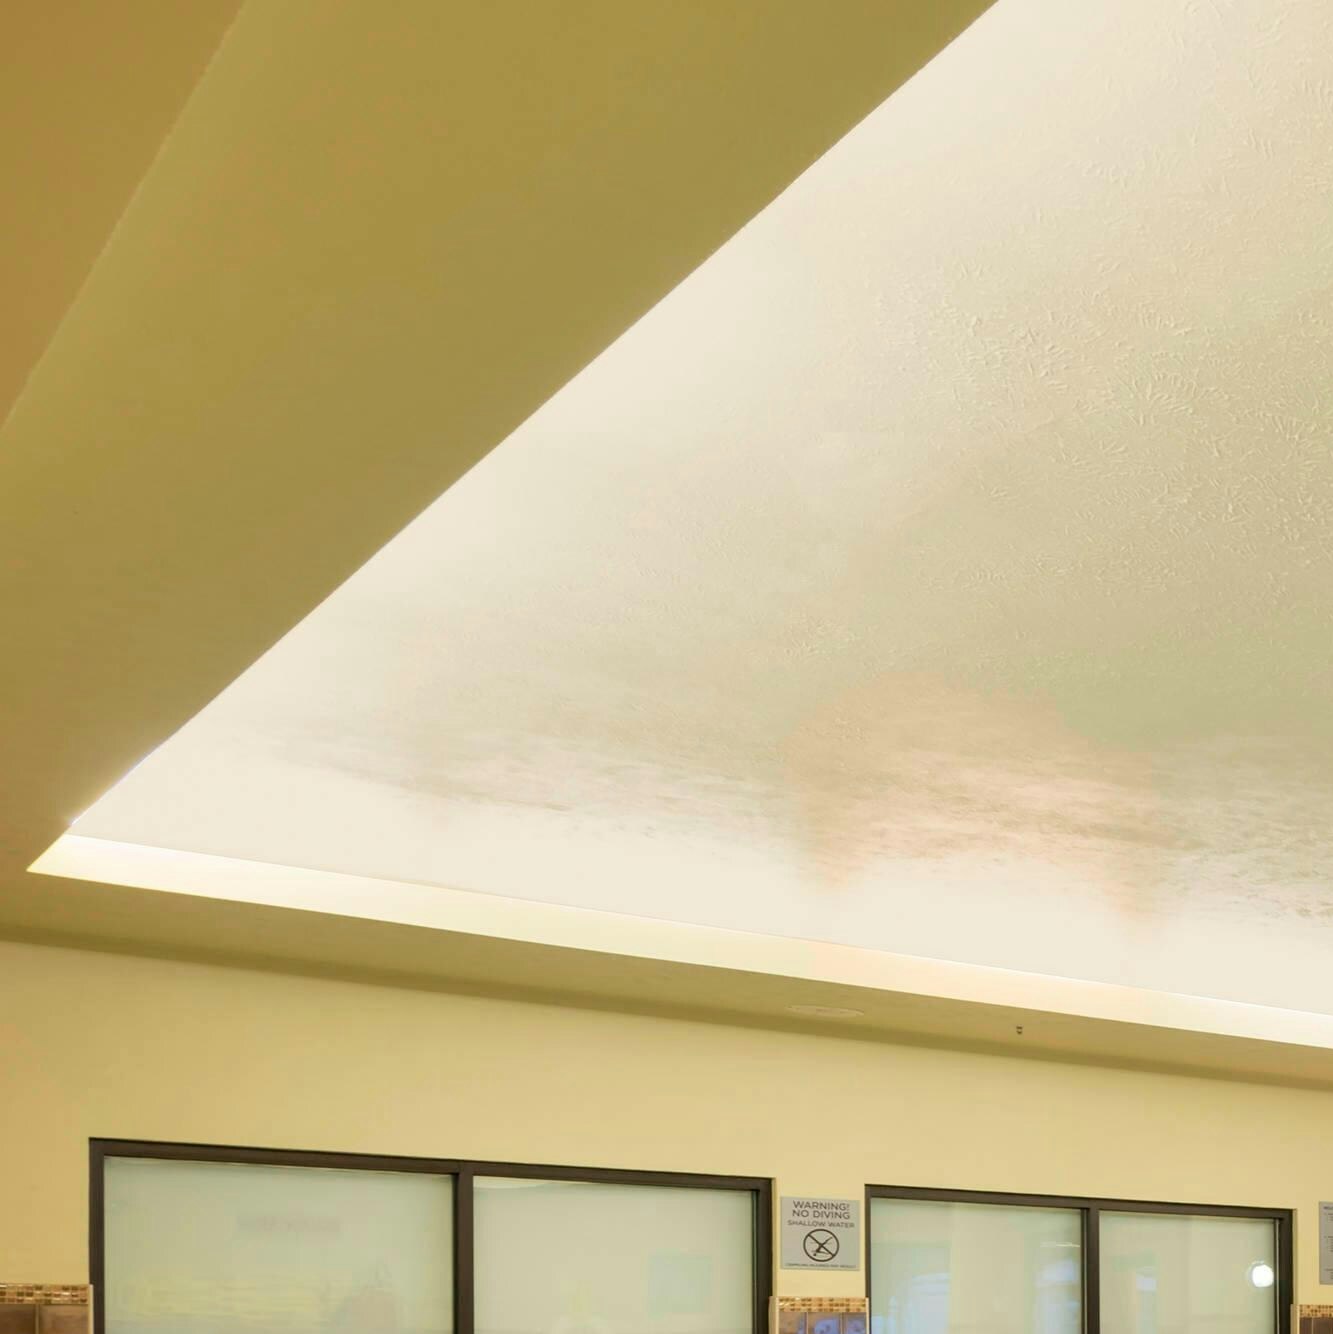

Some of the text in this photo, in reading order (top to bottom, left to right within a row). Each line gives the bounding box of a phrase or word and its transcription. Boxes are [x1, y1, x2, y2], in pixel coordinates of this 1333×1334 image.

[792, 1200, 850, 1211] WARNING!
[792, 1209, 850, 1220] NO DIVING
[787, 1219, 826, 1228] SHALLOW
